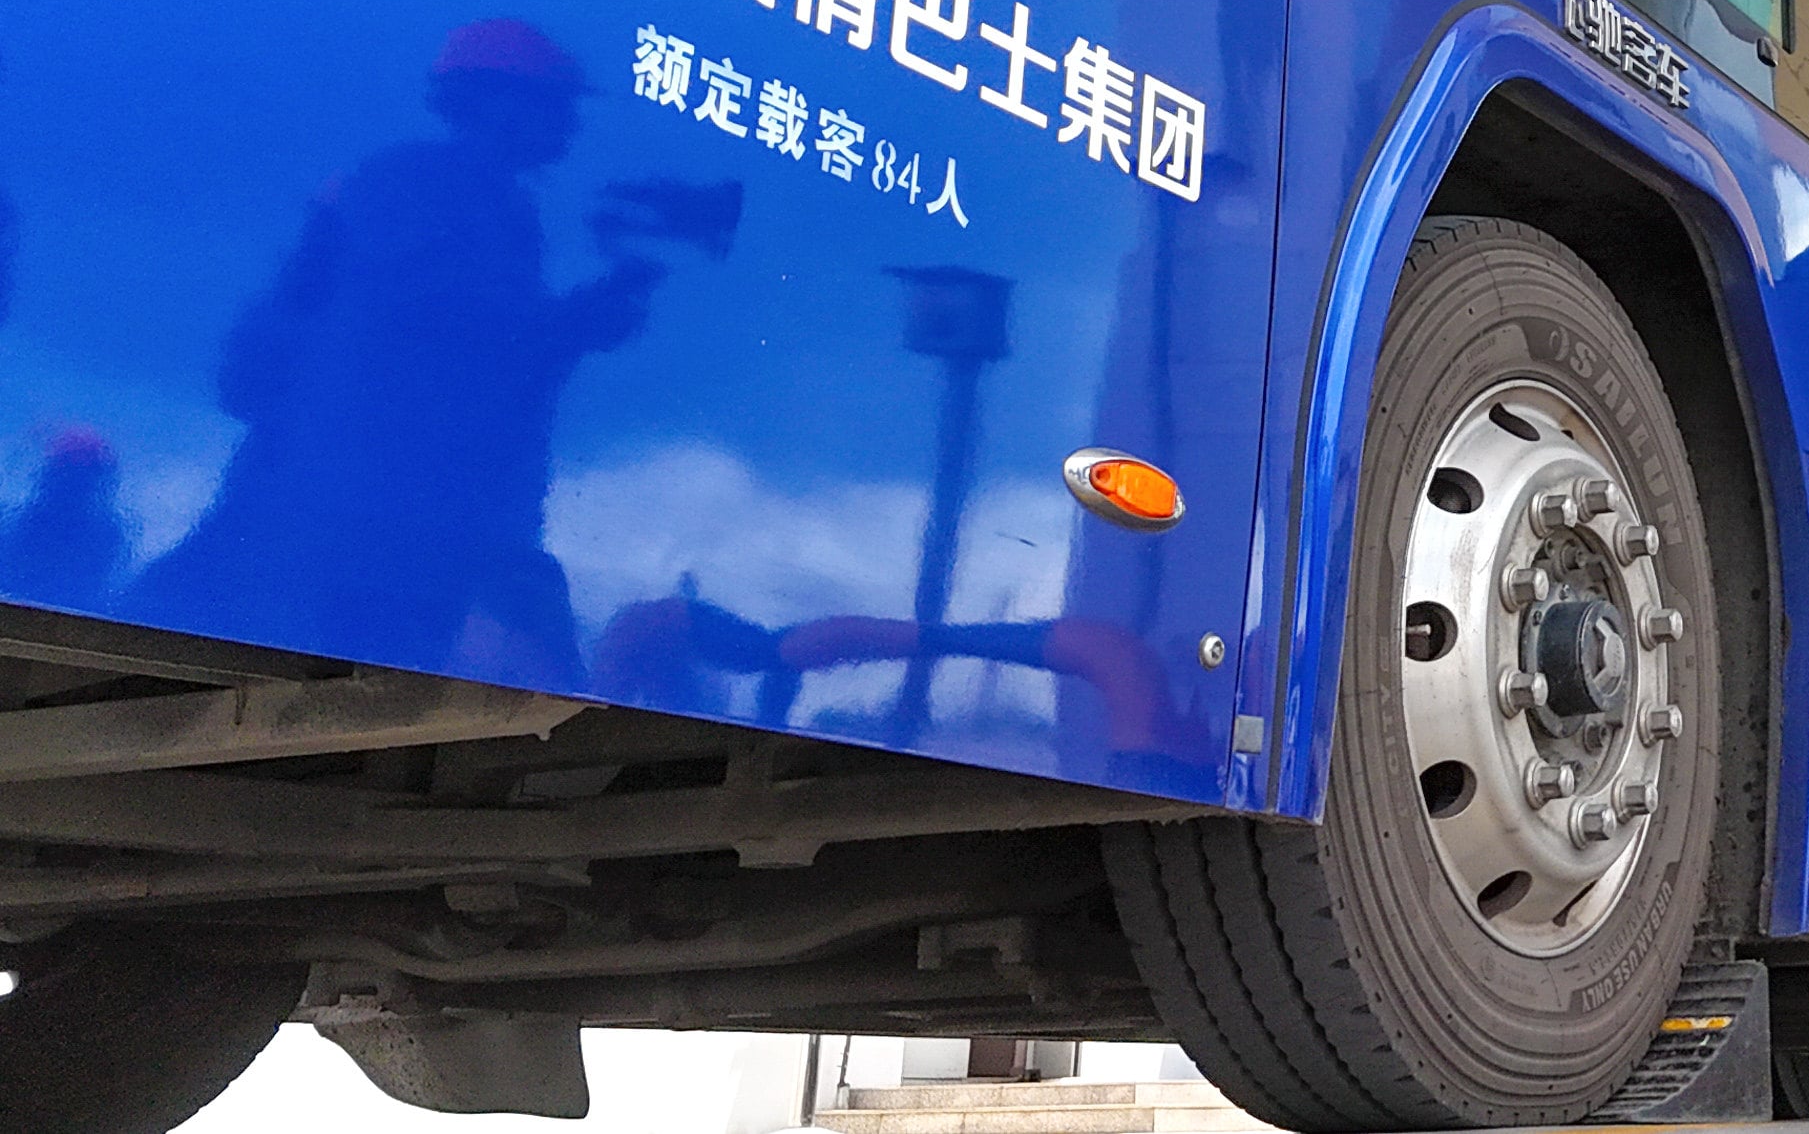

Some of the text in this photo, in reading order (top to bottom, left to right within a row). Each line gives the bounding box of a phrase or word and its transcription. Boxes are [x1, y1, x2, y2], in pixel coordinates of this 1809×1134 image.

[631, 23, 971, 229] 额定载客84人
